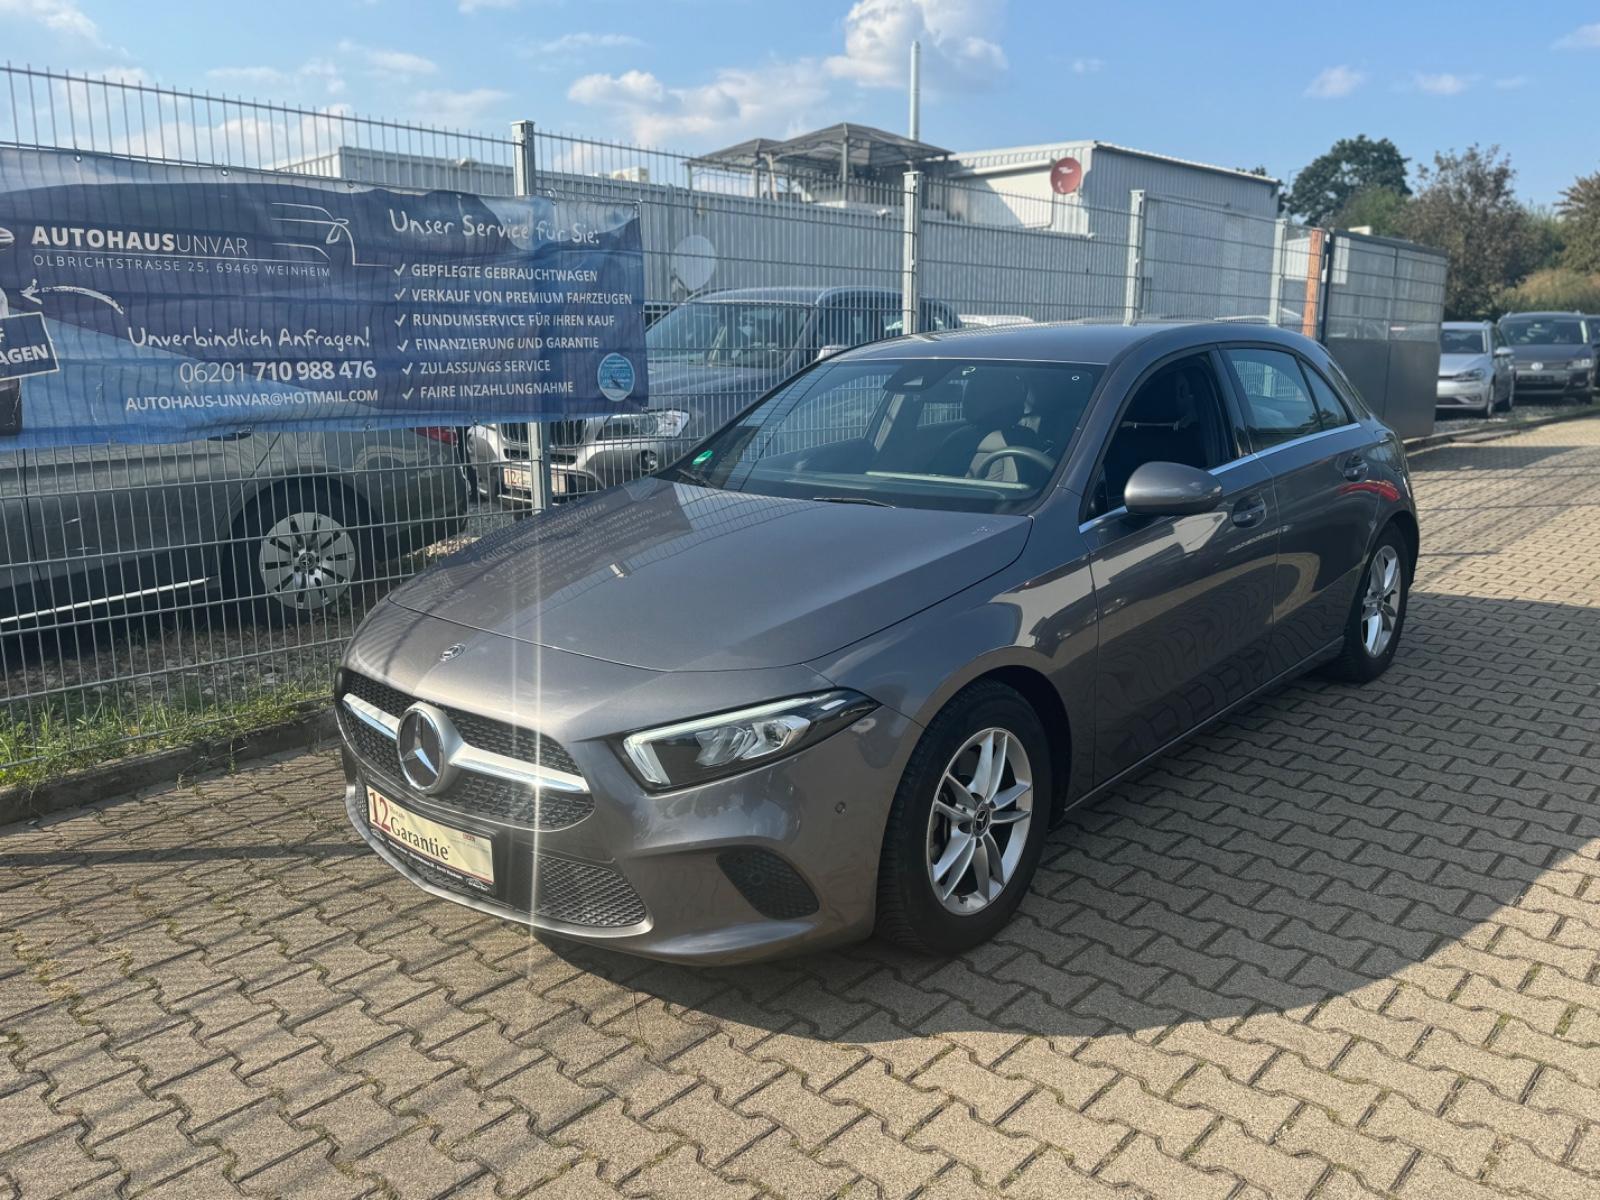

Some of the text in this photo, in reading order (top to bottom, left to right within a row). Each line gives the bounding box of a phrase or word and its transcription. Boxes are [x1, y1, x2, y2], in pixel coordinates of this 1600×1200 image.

[389, 208, 600, 245] Unser Service für Sie:
[33, 254, 331, 277] OLBRICHTSTRASSE 25, 69469 WEINHEIM
[411, 263, 598, 283] GEPFLEGTE GEBRAUCHTWAGEN
[411, 288, 632, 305] VERKAUF VON PREMIUM FAHRZEUGEN
[412, 312, 616, 328] RUNDUMSERVICE FÜR IHREN KAUF
[127, 325, 370, 352] Unverbindlich Anfragen!
[415, 336, 600, 351] FINANZIERUNG UND GARANTIE
[179, 360, 377, 384] 06201 710 988 476
[419, 359, 551, 375] ZULASSUNGS SERVICE
[125, 389, 379, 411] AUTOHAUS-UNVAR@HOTMAIL.COM
[420, 381, 574, 399] FAIRE INZAHLUNGNAHME
[369, 792, 449, 860] 12 Garantie
